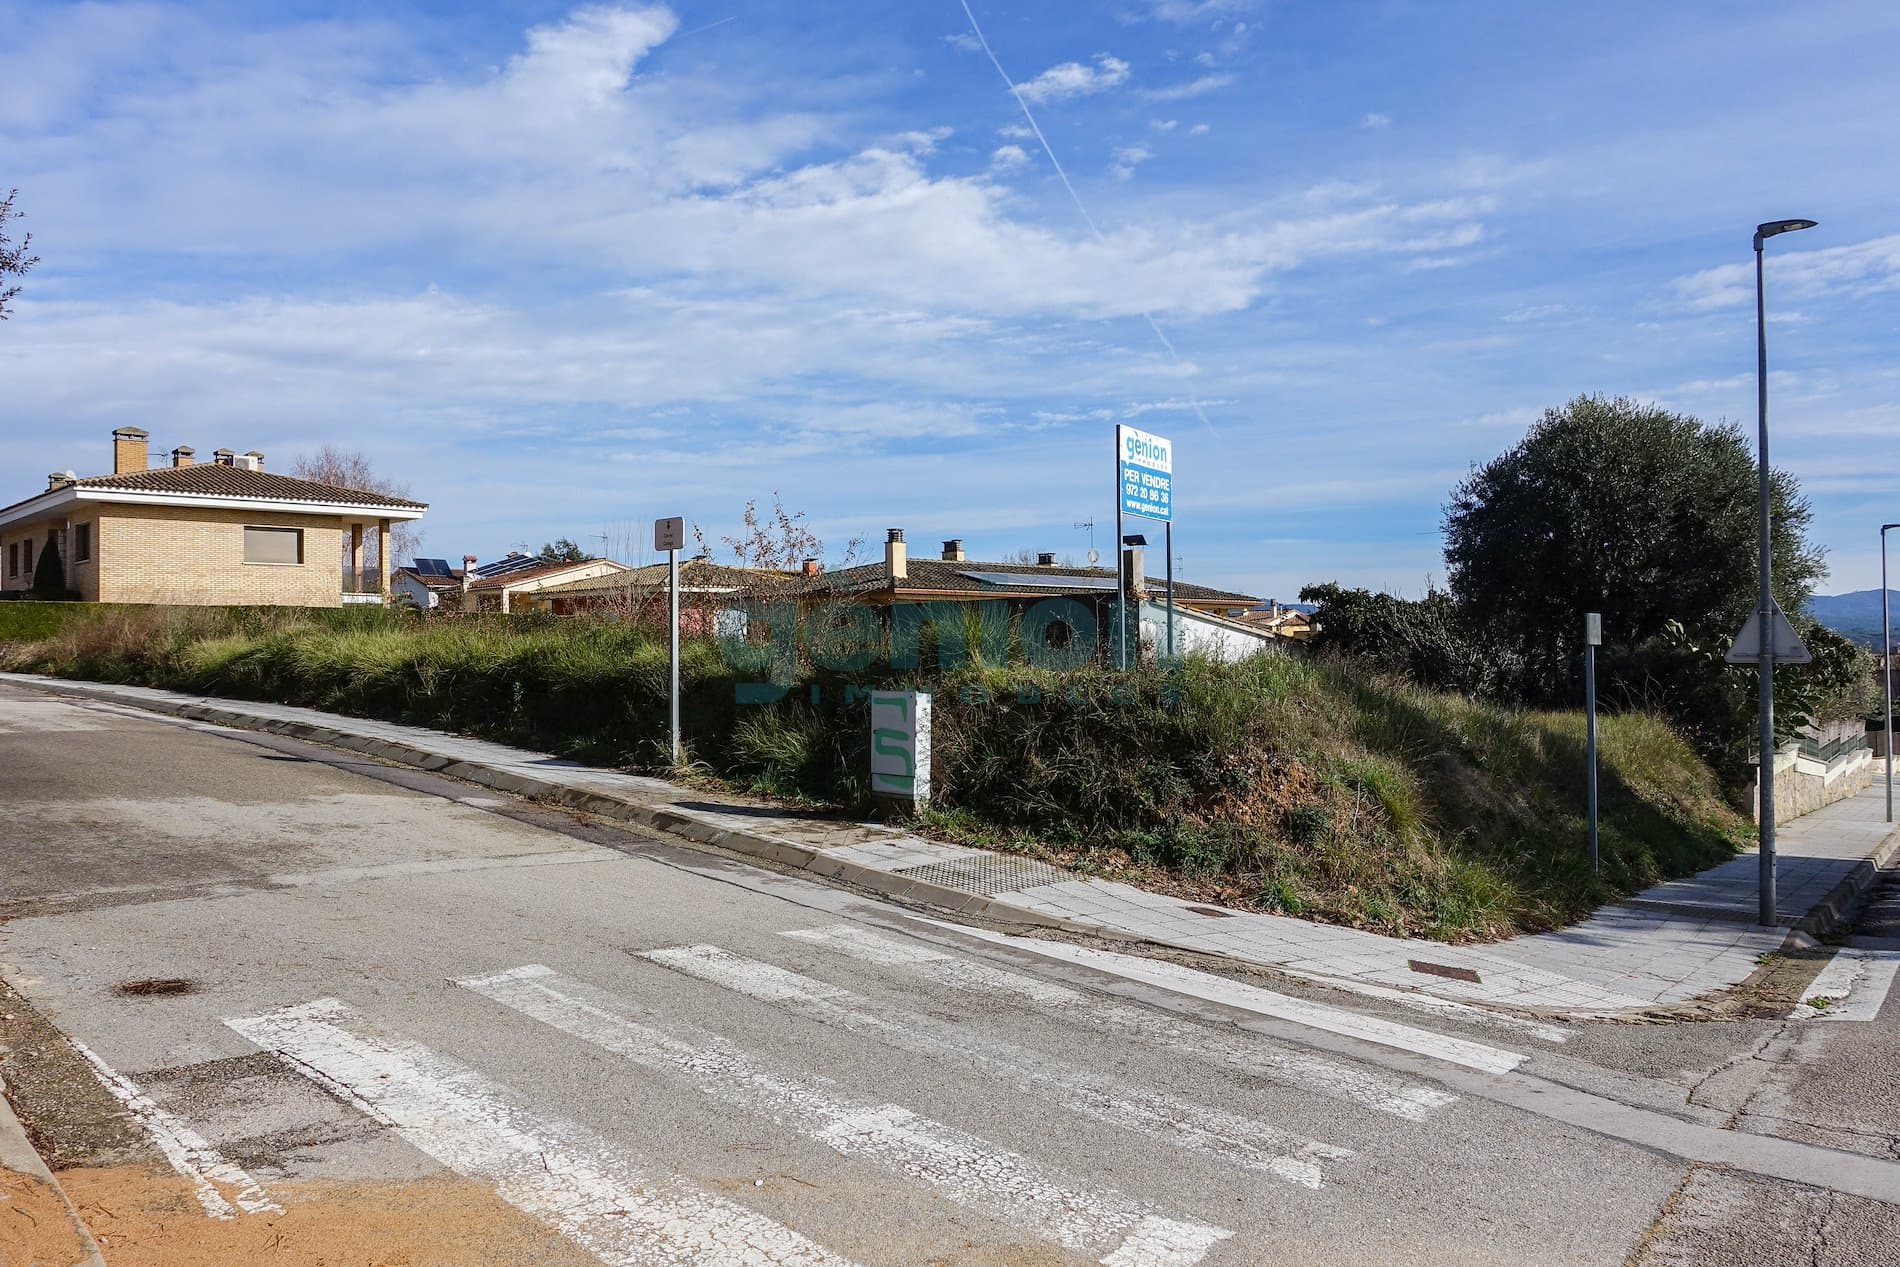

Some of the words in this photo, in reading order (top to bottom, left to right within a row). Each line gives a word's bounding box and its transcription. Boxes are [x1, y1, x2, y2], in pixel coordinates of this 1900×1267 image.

[1126, 430, 1167, 463] gènion
[1124, 468, 1139, 483] PER
[1141, 472, 1170, 491] VENDRE
[1126, 483, 1139, 497] 972
[1140, 487, 1148, 500] 20
[1161, 491, 1169, 504] 36
